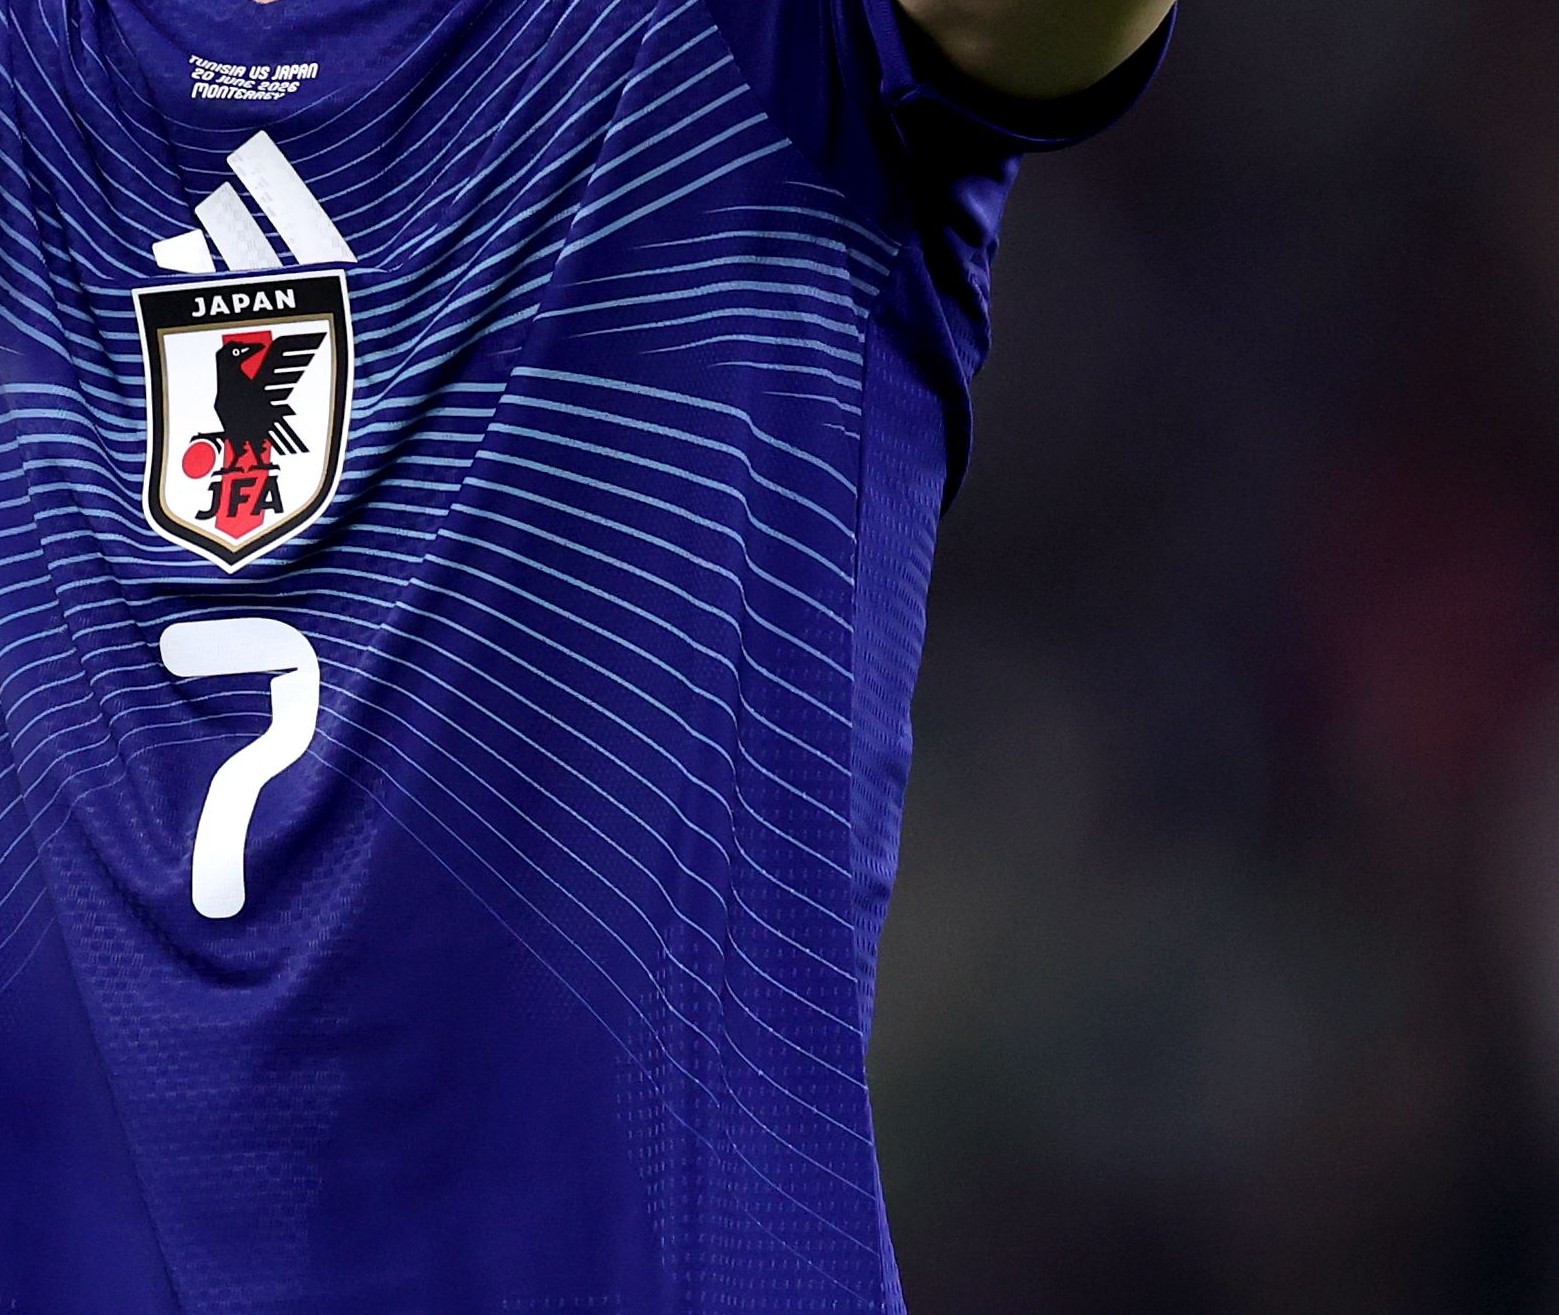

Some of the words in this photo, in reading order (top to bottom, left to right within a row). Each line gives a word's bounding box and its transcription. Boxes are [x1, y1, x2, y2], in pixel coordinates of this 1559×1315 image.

[188, 54, 247, 78] TUNISIA
[271, 62, 319, 81] JAPAN
[191, 67, 215, 81] 20
[215, 75, 256, 89] JUNE
[257, 81, 301, 93] 2026
[191, 82, 285, 100] MONTERREY
[191, 288, 297, 317] JAPAN
[195, 475, 285, 520] JFA
[159, 617, 321, 919] 7
